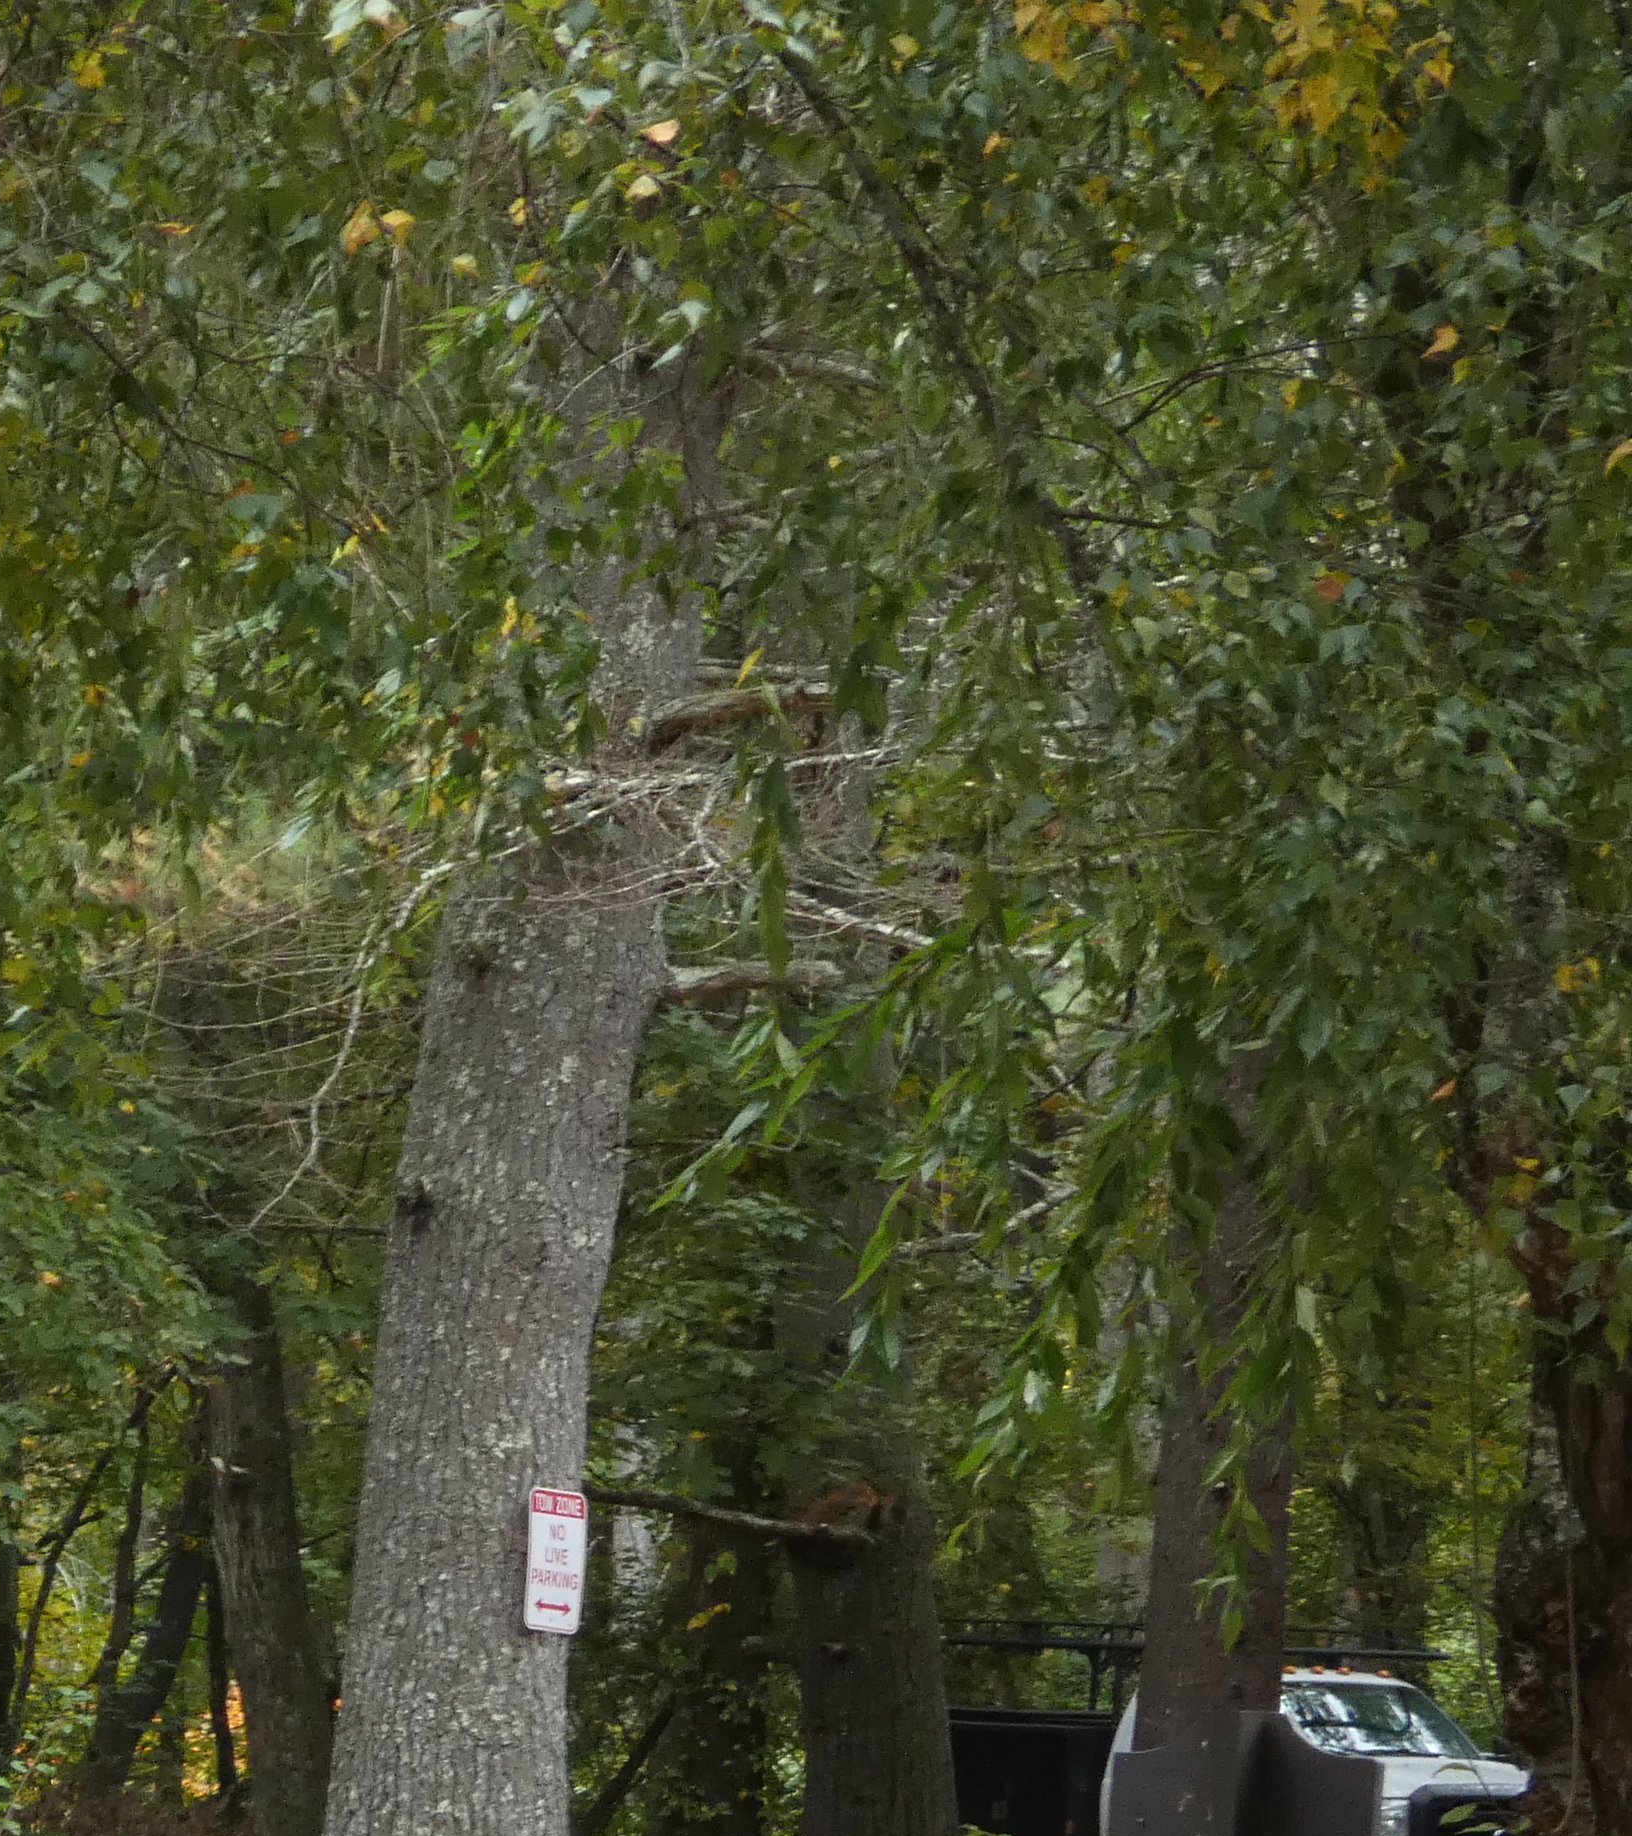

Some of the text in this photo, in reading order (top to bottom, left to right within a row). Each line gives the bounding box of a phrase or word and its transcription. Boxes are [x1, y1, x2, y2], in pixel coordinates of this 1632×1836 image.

[534, 1493, 582, 1516] TOW ZONE
[549, 1524, 566, 1540] NO
[545, 1547, 569, 1565] LIVE
[532, 1569, 578, 1590] PARKING
